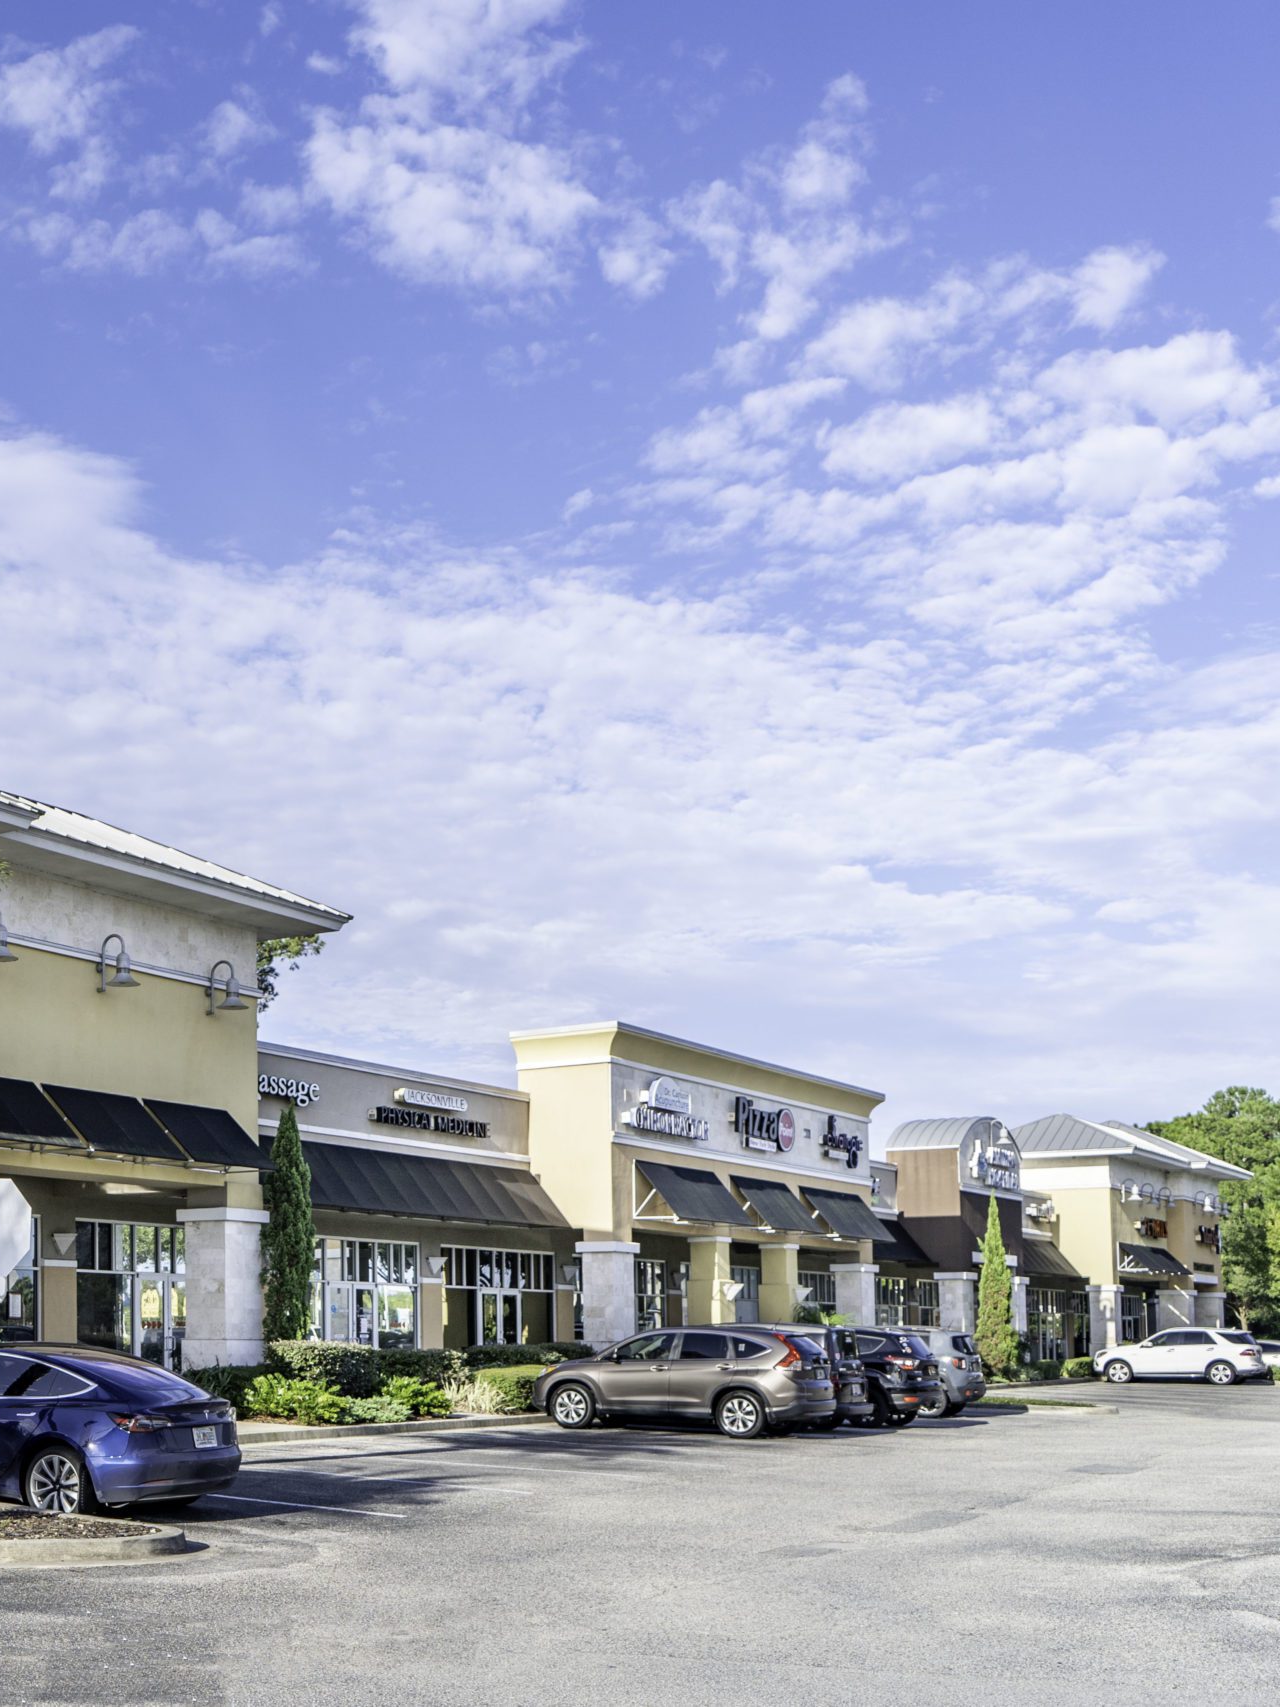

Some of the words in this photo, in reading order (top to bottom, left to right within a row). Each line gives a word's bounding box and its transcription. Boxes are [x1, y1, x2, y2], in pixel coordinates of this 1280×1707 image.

[256, 1074, 320, 1107] assage
[406, 1088, 465, 1110] JACKSONVILLE
[435, 1114, 491, 1138] MEDICINE
[735, 1096, 778, 1141] Pizza
